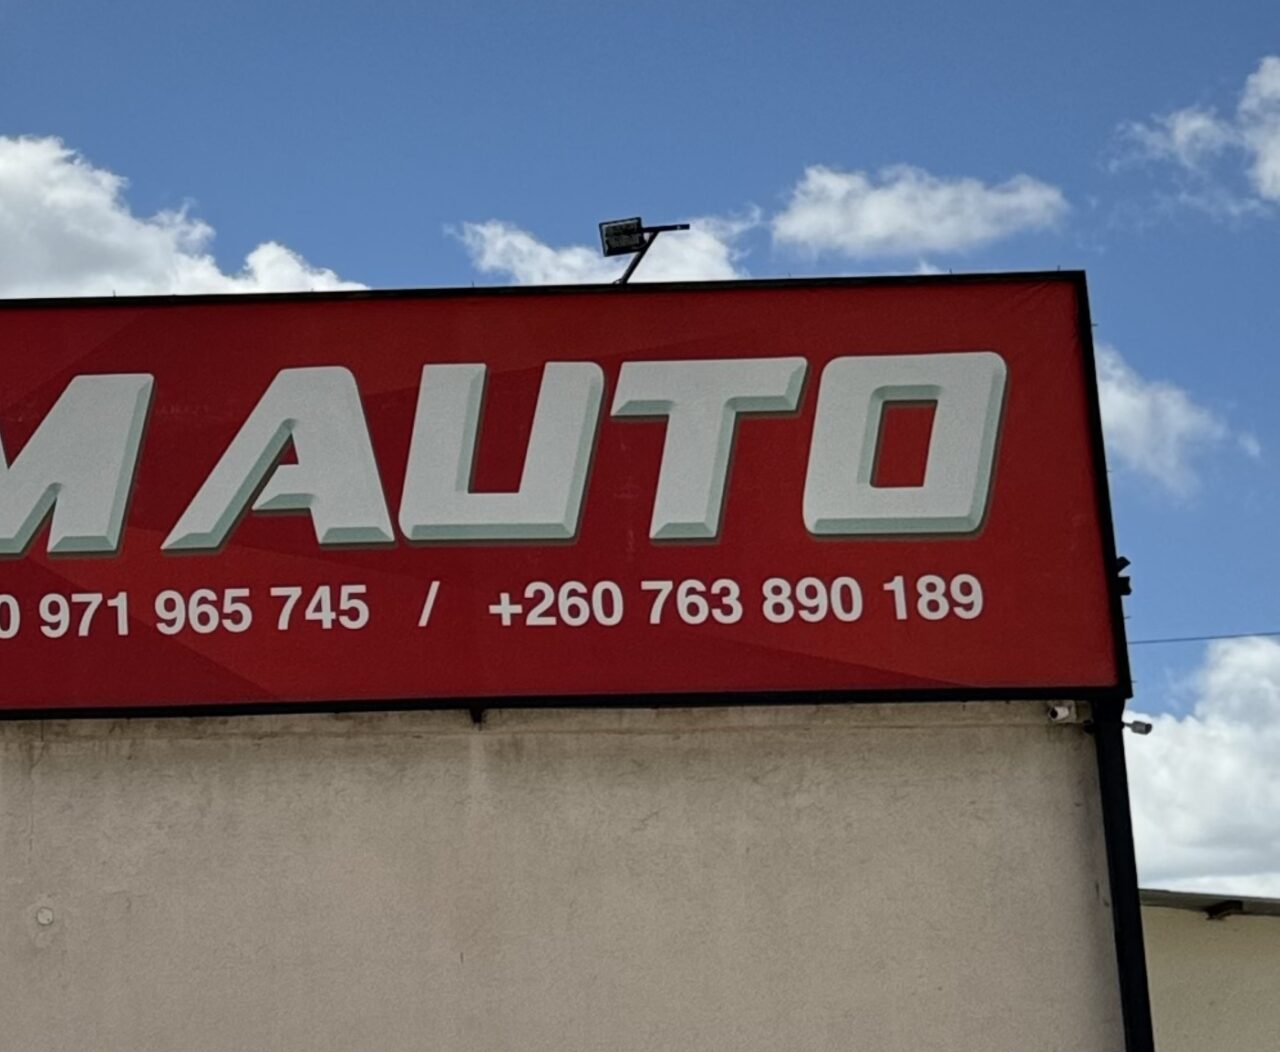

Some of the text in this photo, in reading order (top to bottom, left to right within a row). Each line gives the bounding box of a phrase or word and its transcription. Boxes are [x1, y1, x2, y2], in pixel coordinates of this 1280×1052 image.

[160, 351, 1008, 551] AUTO
[38, 591, 129, 638] 971
[154, 588, 253, 635] 965
[270, 584, 370, 631] 745
[488, 580, 624, 627] +260
[641, 578, 743, 625] 763
[762, 576, 863, 623] 890
[883, 573, 984, 620] 189
